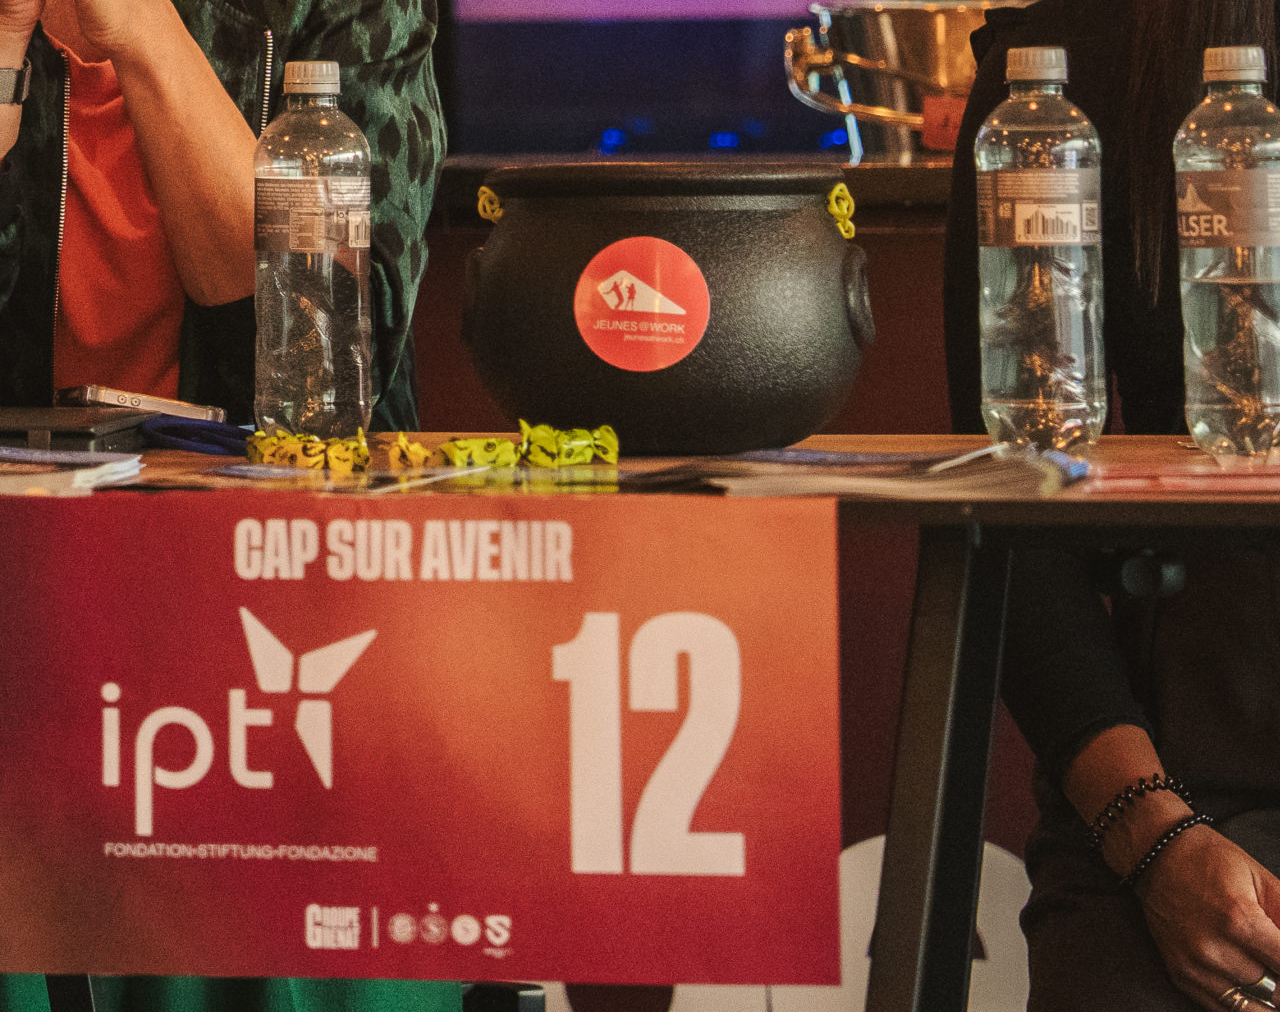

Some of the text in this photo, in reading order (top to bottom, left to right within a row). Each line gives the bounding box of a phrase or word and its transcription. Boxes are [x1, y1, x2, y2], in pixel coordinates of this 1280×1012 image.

[234, 518, 573, 582] CAP SUR AVENIR
[101, 682, 274, 837] ipt
[551, 610, 746, 876] 12
